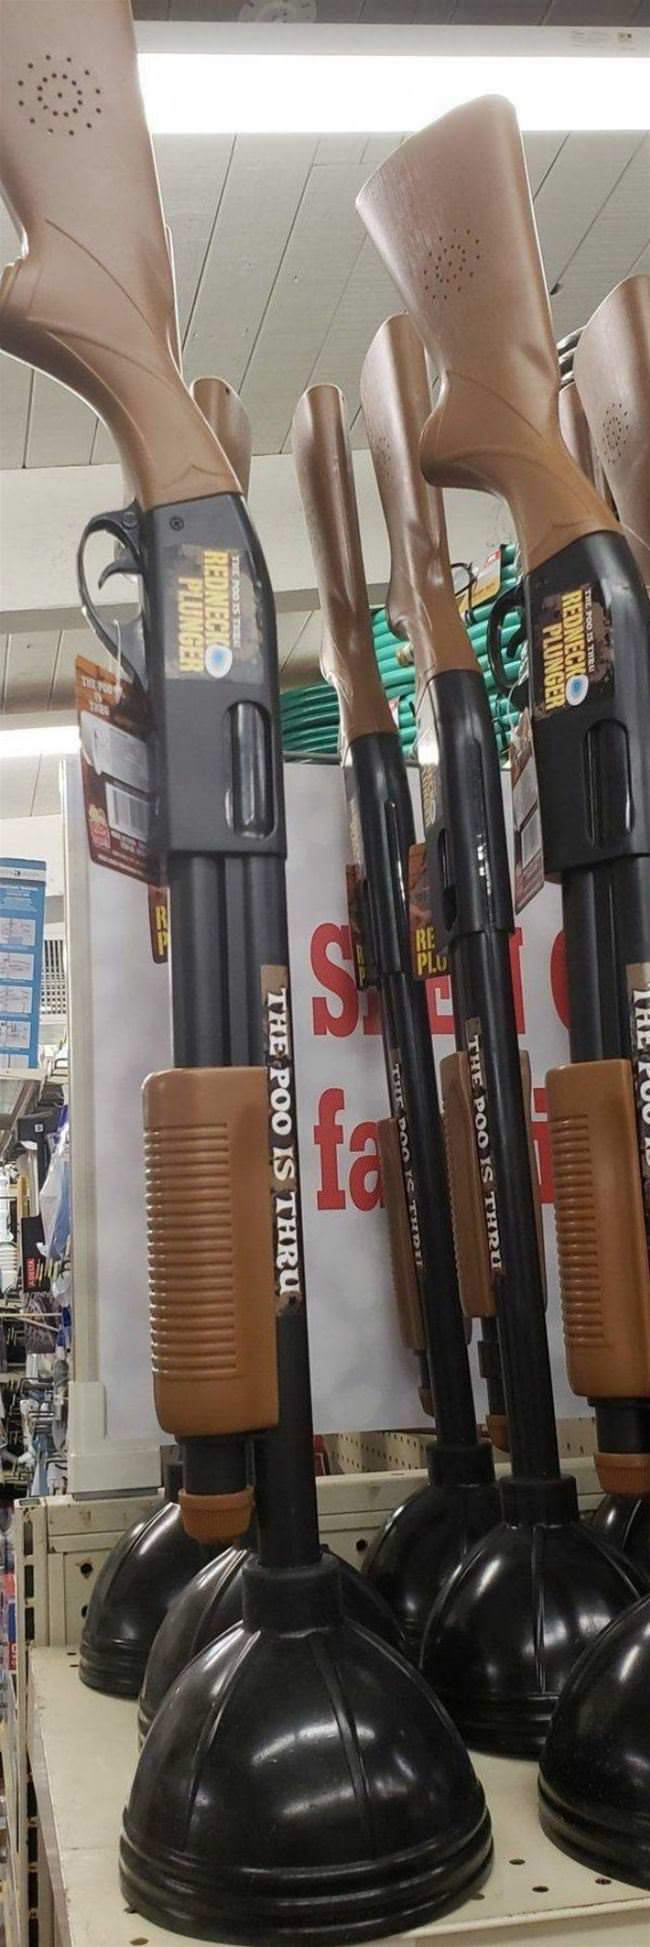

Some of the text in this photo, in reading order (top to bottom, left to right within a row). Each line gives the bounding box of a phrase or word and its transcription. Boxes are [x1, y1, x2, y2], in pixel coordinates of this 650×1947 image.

[178, 577, 204, 672] PLUNGER
[203, 550, 231, 648] REDNECK
[561, 589, 587, 680] REDNECK
[542, 621, 566, 710] PLUNGER
[267, 987, 301, 1297] THE POO IS THRU
[398, 1118, 410, 1163] POO
[468, 1034, 502, 1269] THE POO IS THRU
